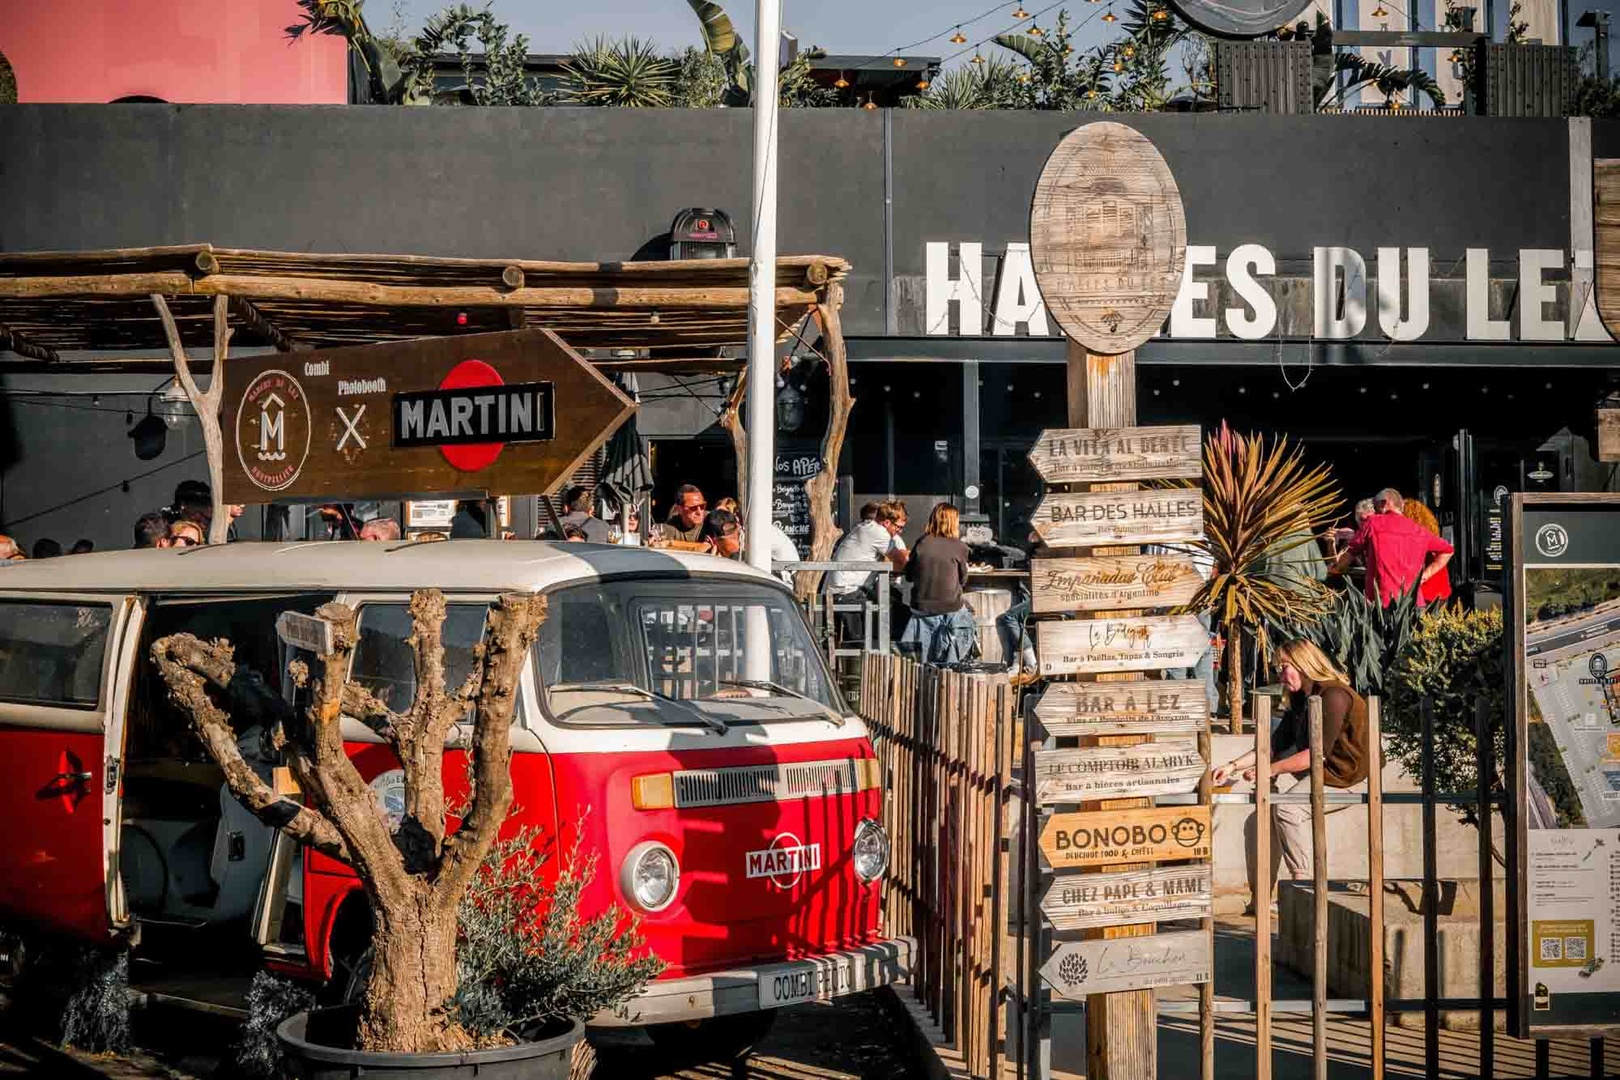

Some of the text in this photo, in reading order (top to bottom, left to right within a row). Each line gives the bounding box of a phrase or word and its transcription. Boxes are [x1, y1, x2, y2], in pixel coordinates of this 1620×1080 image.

[926, 242, 1277, 340] HAES
[1313, 247, 1430, 341] DU
[304, 360, 330, 376] Combi
[338, 377, 387, 395] Photobooth
[401, 392, 545, 439] MARTINI
[1050, 440, 1068, 457] LA
[1116, 438, 1135, 455] AL
[1051, 501, 1198, 522] BAR DES HALLES
[1063, 655, 1080, 663] Bar
[1119, 652, 1143, 662] Tapas
[1144, 652, 1151, 660] &
[1152, 650, 1185, 661] Sangria
[1075, 695, 1115, 713] BAR
[1146, 689, 1181, 713] LEZ
[1068, 757, 1140, 774] COMPTOIR
[1065, 782, 1083, 791] Bar
[1094, 779, 1124, 789] bières
[1127, 776, 1180, 787] artisanales
[1055, 824, 1167, 851] BONOBO
[749, 846, 819, 875] MARTINI
[1121, 848, 1129, 859] &
[1062, 887, 1097, 904] CHEZ
[1145, 882, 1157, 897] &
[773, 964, 851, 1001] COMBI PHOTO
